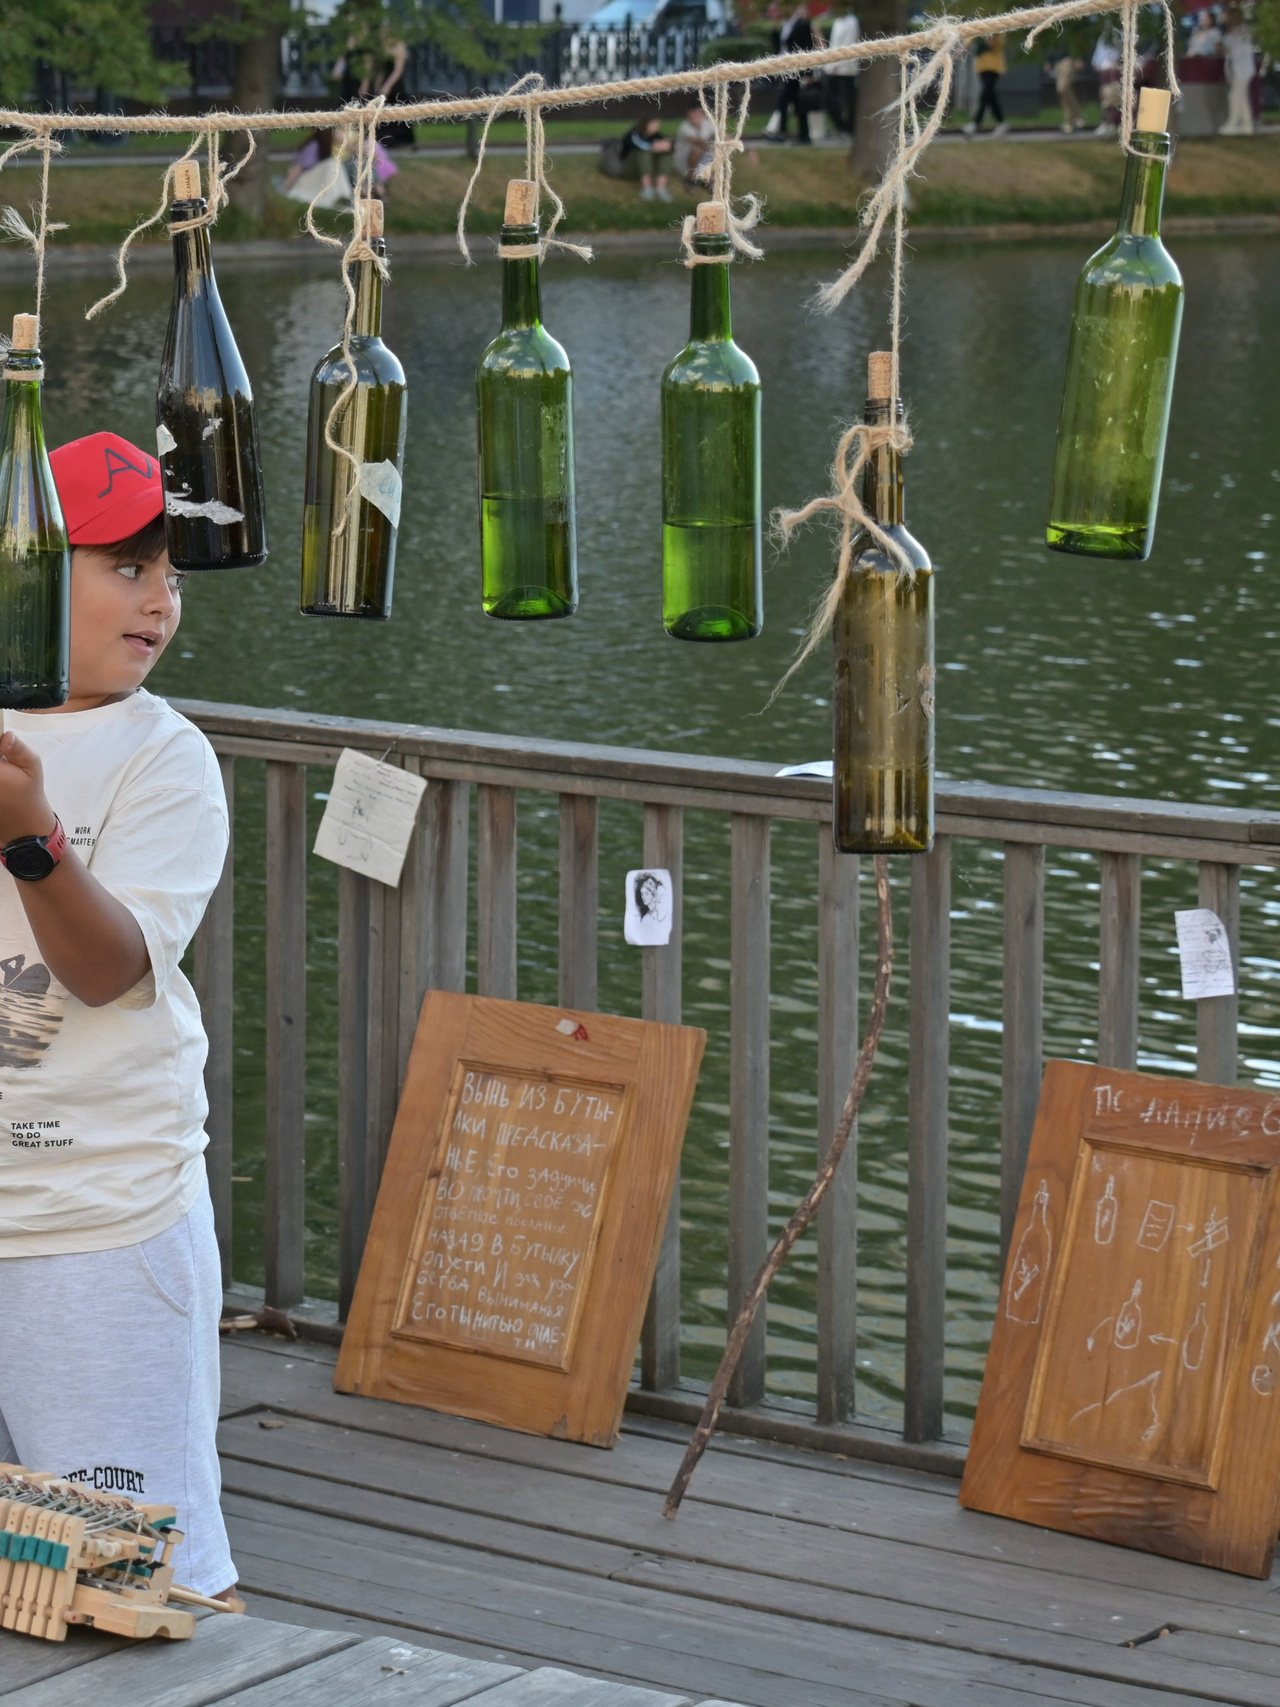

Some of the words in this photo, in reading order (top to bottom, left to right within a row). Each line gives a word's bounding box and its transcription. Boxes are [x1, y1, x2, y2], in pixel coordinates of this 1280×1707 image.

[74, 826, 92, 835] WORK
[461, 1071, 510, 1108] ВЫНЬ
[518, 1083, 547, 1111] ИЗ
[10, 1122, 35, 1130] TAKE
[37, 1120, 61, 1129] TIME
[452, 1109, 487, 1141] ЛКИ
[26, 1131, 41, 1139] DO
[12, 1140, 41, 1148] GREAT
[44, 1138, 74, 1148] STUFF
[436, 1176, 465, 1201] ВО
